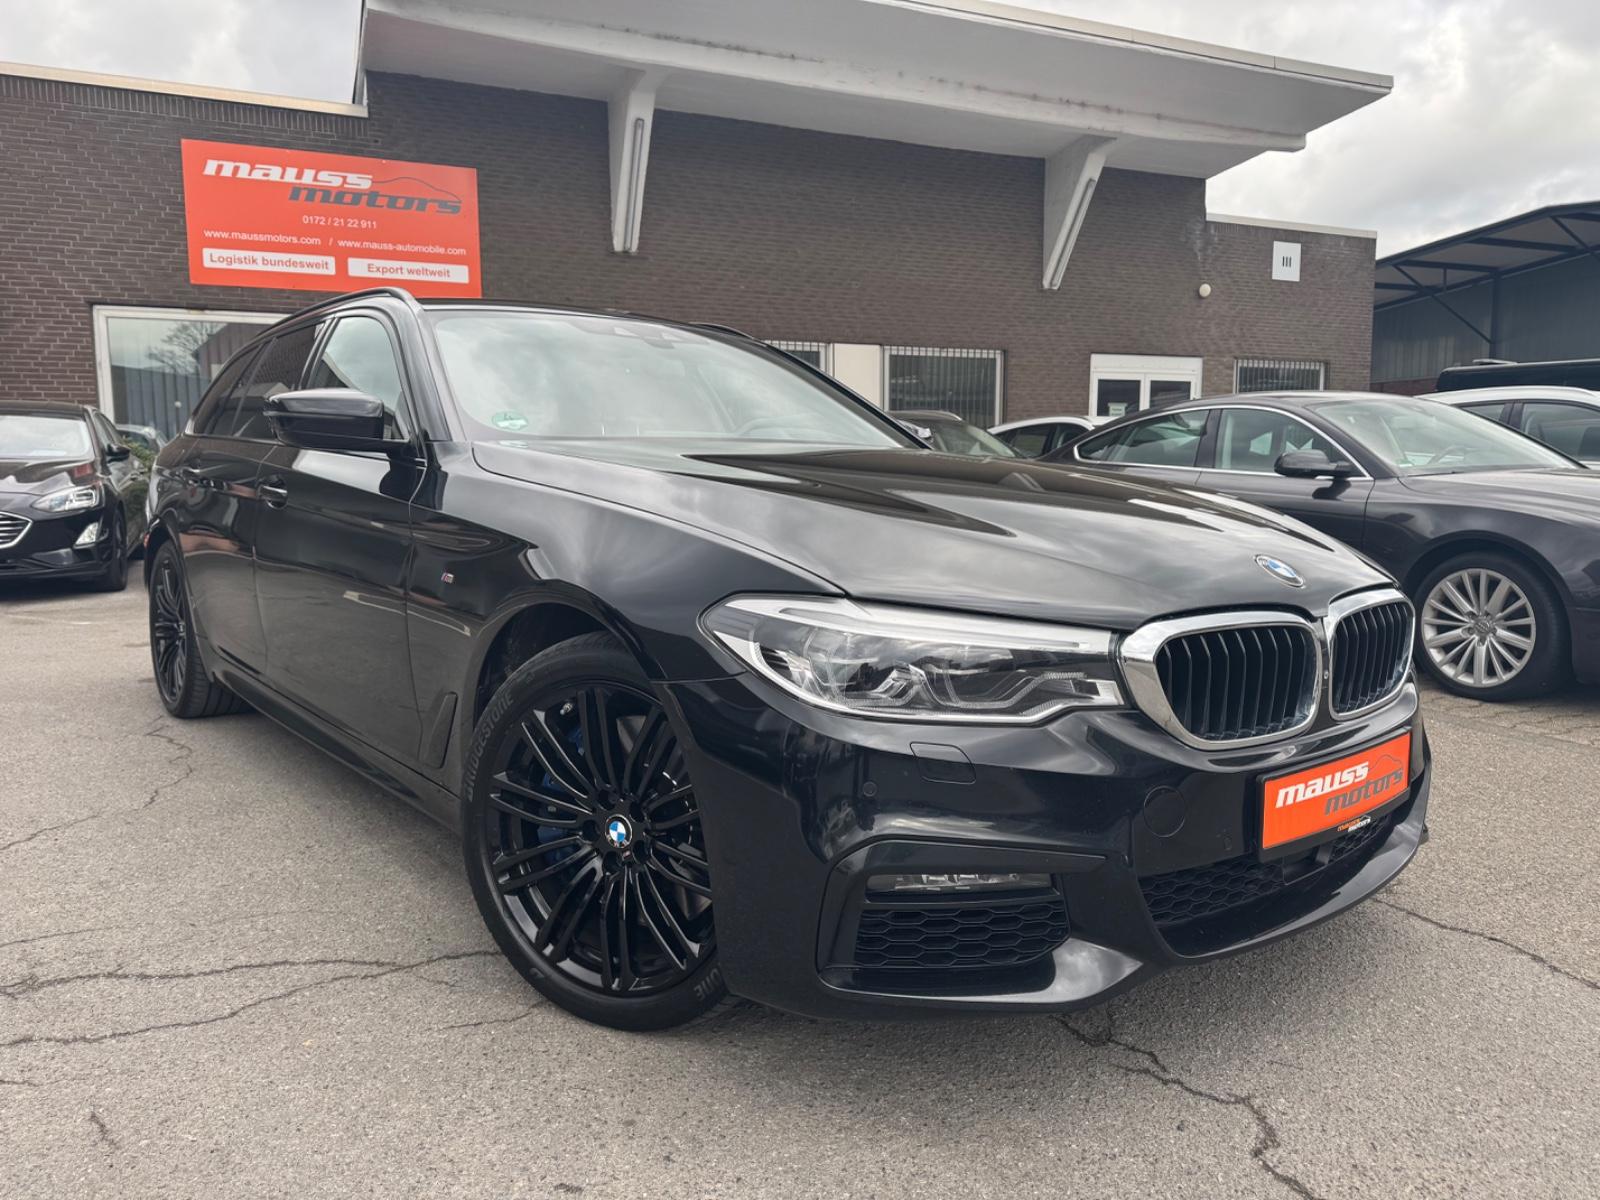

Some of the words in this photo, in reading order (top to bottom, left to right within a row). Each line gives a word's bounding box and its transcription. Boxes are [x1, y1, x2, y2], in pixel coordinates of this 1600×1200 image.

[203, 159, 373, 190] mauss
[288, 186, 463, 215] motors
[302, 215, 326, 225] 0172
[333, 217, 345, 226] 21
[347, 218, 359, 228] 22
[360, 219, 377, 229] 911
[203, 229, 321, 246] www.maussmotors.com
[337, 239, 467, 256] www.mauss-automobile.com
[209, 252, 258, 267] Logistik
[261, 256, 329, 271] bundesweit
[367, 263, 404, 276] Export
[406, 267, 451, 278] weltweit
[463, 689, 515, 803] BRIDGESTONE
[1275, 761, 1369, 809] mauss
[1324, 768, 1404, 816] motors
